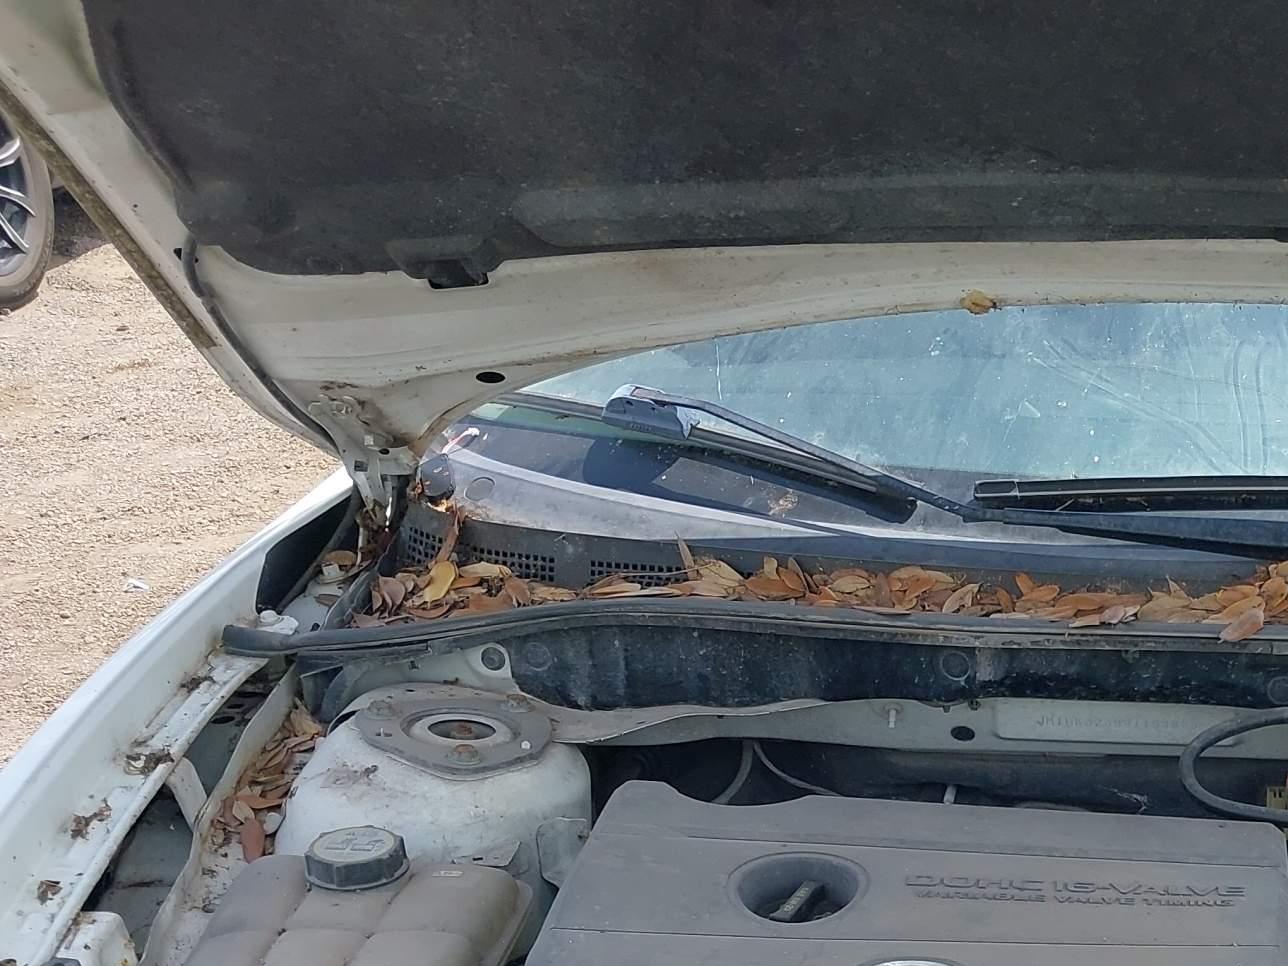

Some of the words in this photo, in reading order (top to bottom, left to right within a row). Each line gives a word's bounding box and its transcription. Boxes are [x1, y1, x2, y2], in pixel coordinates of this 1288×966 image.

[905, 875, 1044, 892] DOHC
[1053, 880, 1247, 898] 16-VALVE
[1054, 896, 1136, 906] VALVE
[1141, 898, 1236, 908] TIMING
